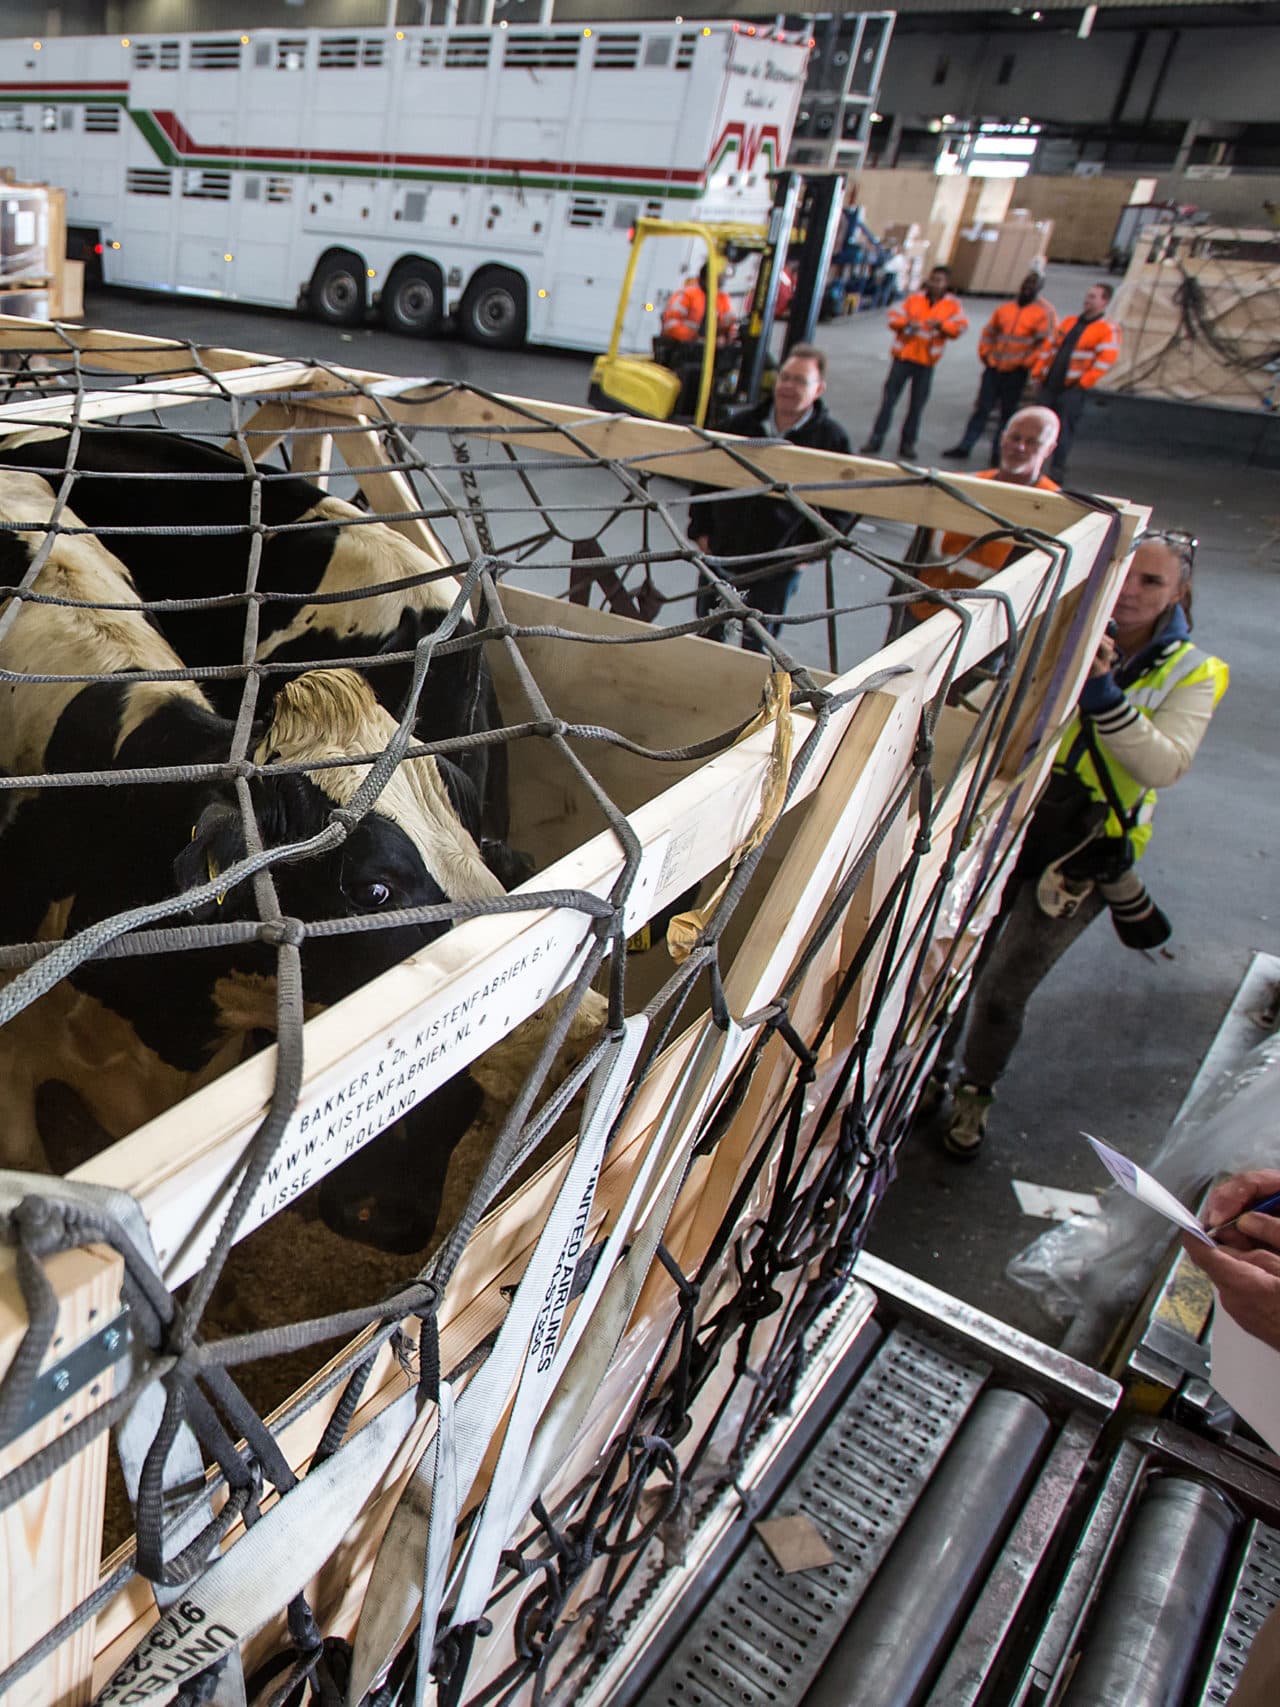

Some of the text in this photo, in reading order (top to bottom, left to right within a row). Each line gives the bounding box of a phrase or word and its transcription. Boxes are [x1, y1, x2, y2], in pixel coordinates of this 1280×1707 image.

[267, 1023, 472, 1185] WWW.KISTENFABRIEK.NL
[300, 1071, 369, 1134] BAKKER
[376, 1060, 385, 1077] &
[415, 954, 528, 1049] KISTENFABRIEK
[260, 1168, 312, 1218] LISSE
[344, 1089, 417, 1154] HOLLAND
[537, 1265, 574, 1374] AIRLINES
[118, 1623, 239, 1706] UNITED
